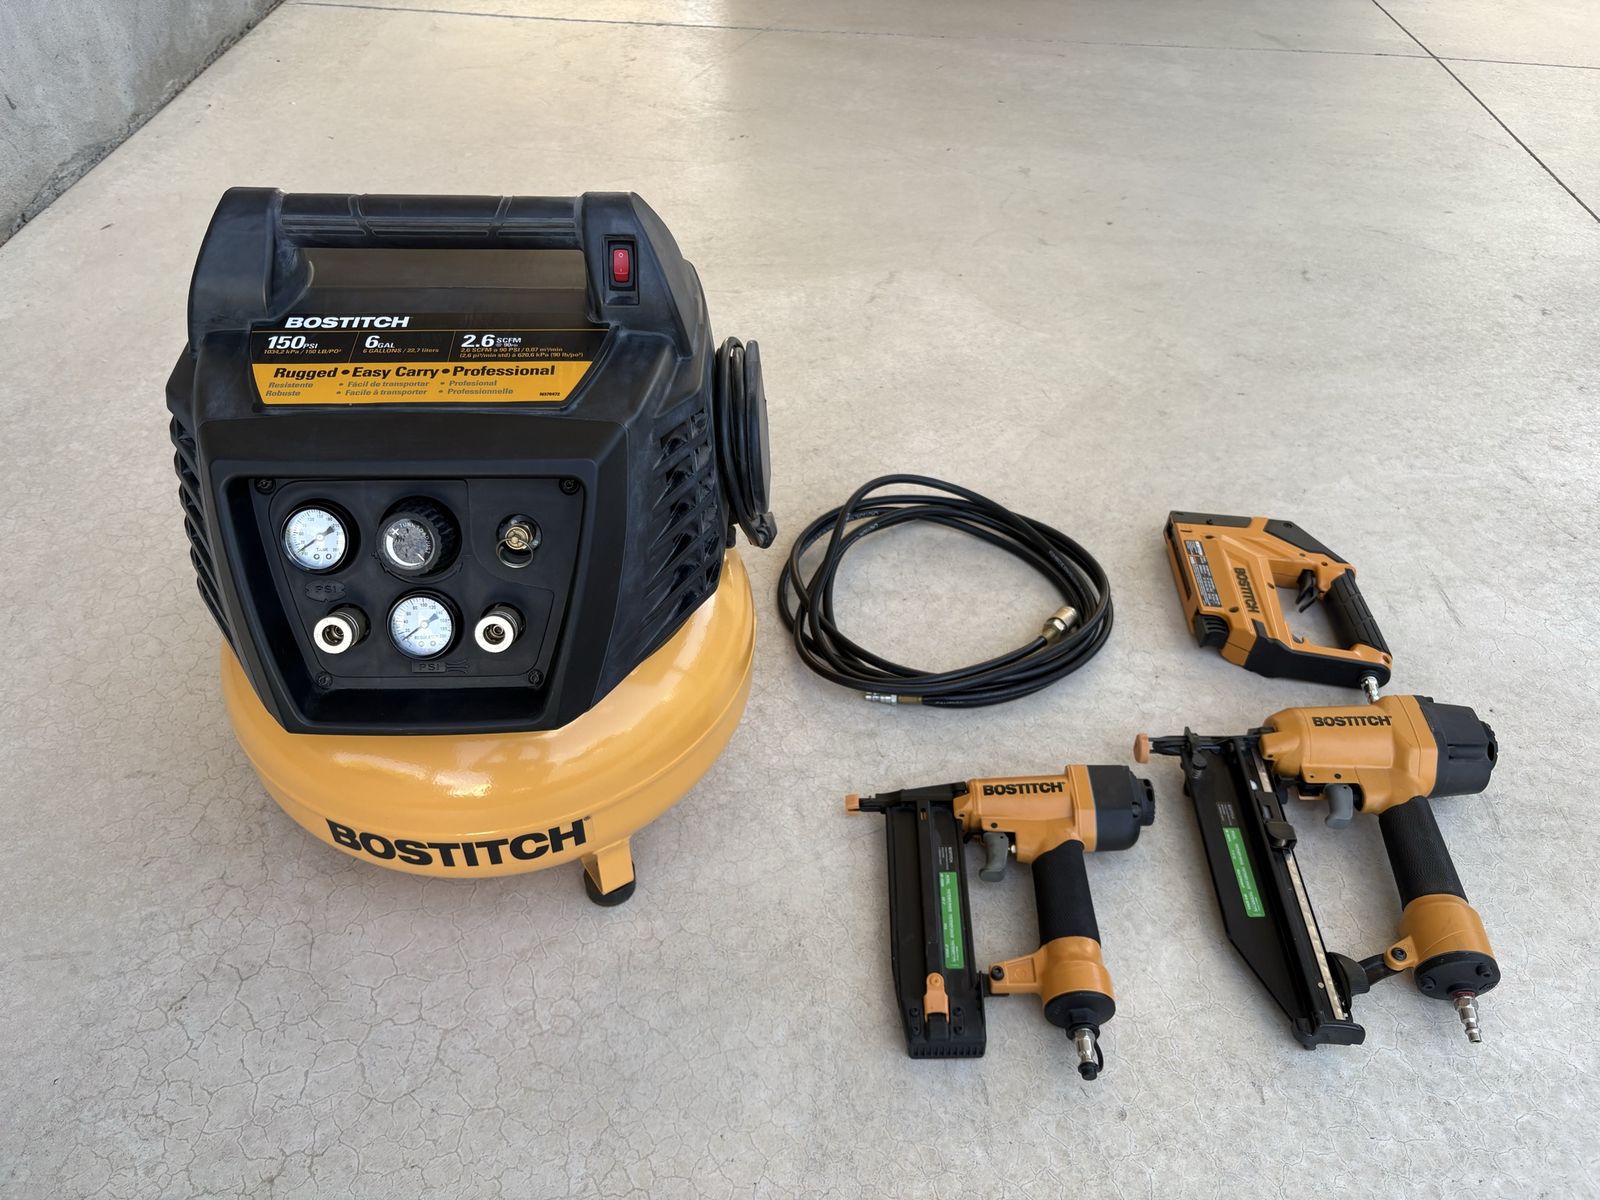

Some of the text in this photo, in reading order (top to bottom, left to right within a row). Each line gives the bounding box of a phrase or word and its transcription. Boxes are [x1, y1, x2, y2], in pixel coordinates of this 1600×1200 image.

[285, 316, 410, 328] BOSTITCH
[461, 334, 495, 347] 2.6
[273, 365, 555, 380] Rugged Easy Carry Professional
[1233, 567, 1260, 613] BOSTITCH
[419, 663, 440, 671] PSI
[1311, 715, 1392, 727] BOSTITCH
[982, 782, 1064, 796] BOSTITCH
[325, 817, 589, 867] BOSTITCH
